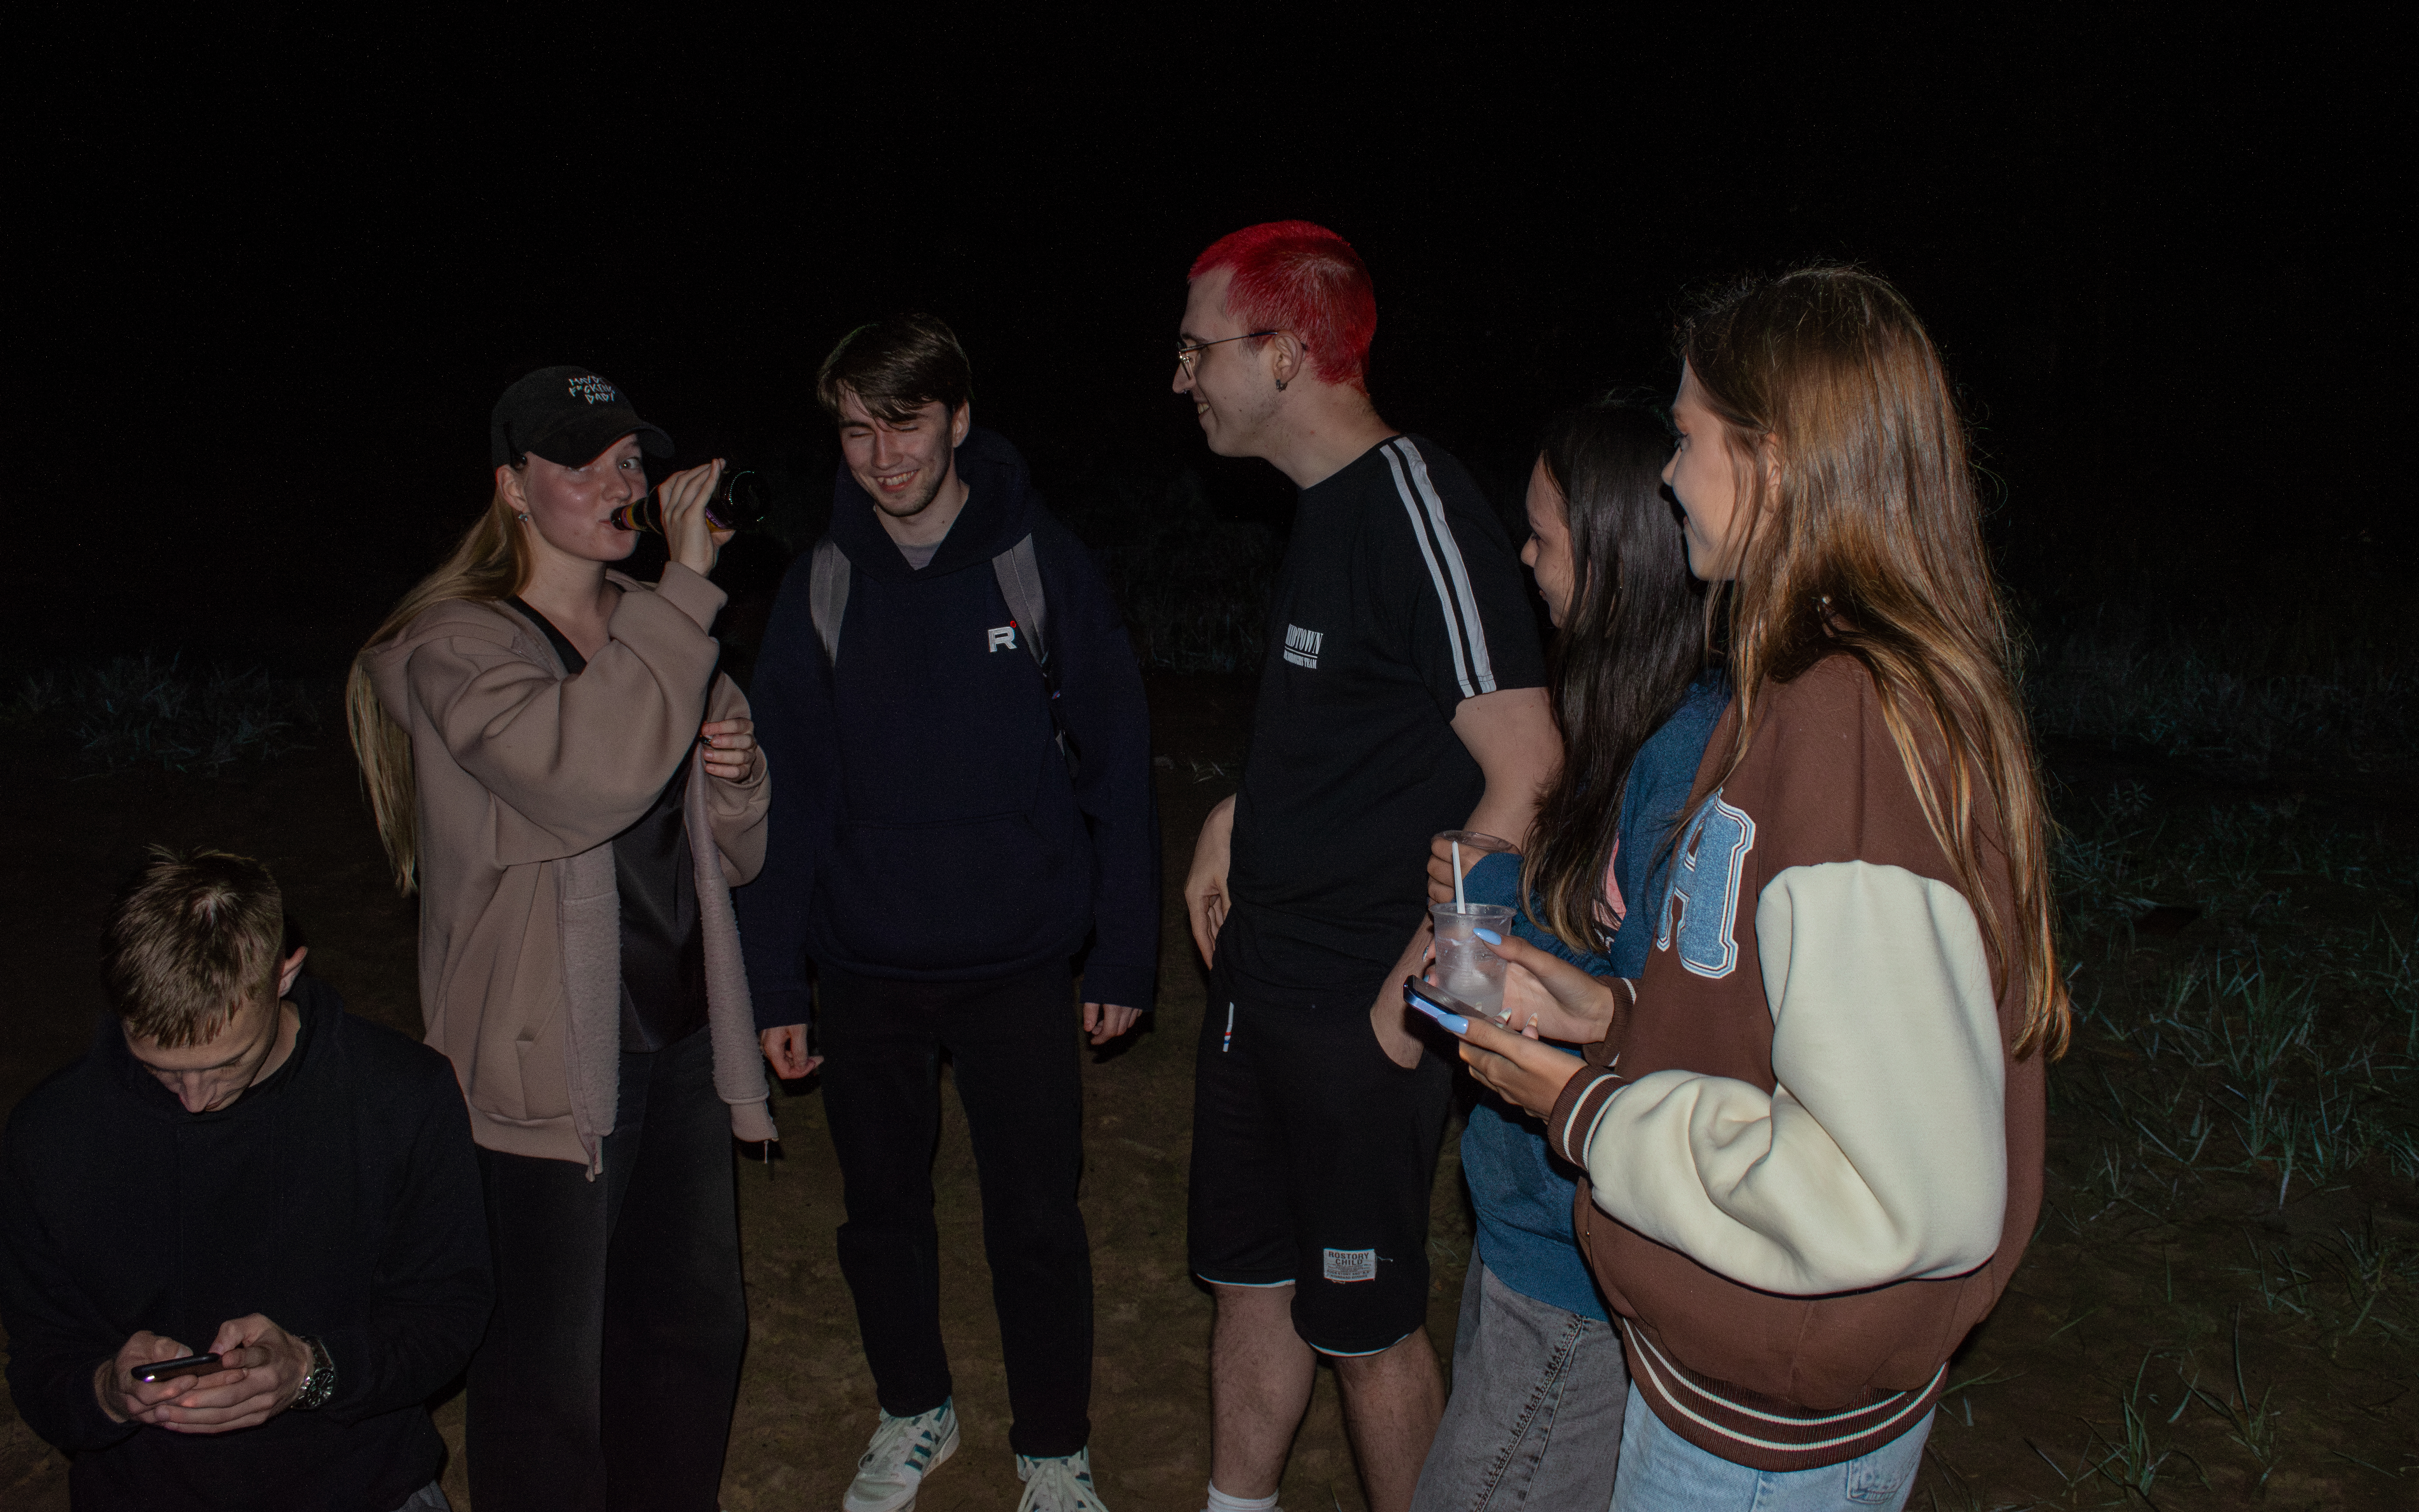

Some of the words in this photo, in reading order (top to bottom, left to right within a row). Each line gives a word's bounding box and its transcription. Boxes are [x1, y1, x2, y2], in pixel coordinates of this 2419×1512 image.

[988, 626, 1017, 653] R
[1304, 657, 1317, 669] TEAM
[1656, 787, 1756, 979] A
[1328, 1251, 1369, 1259] ROSTORY
